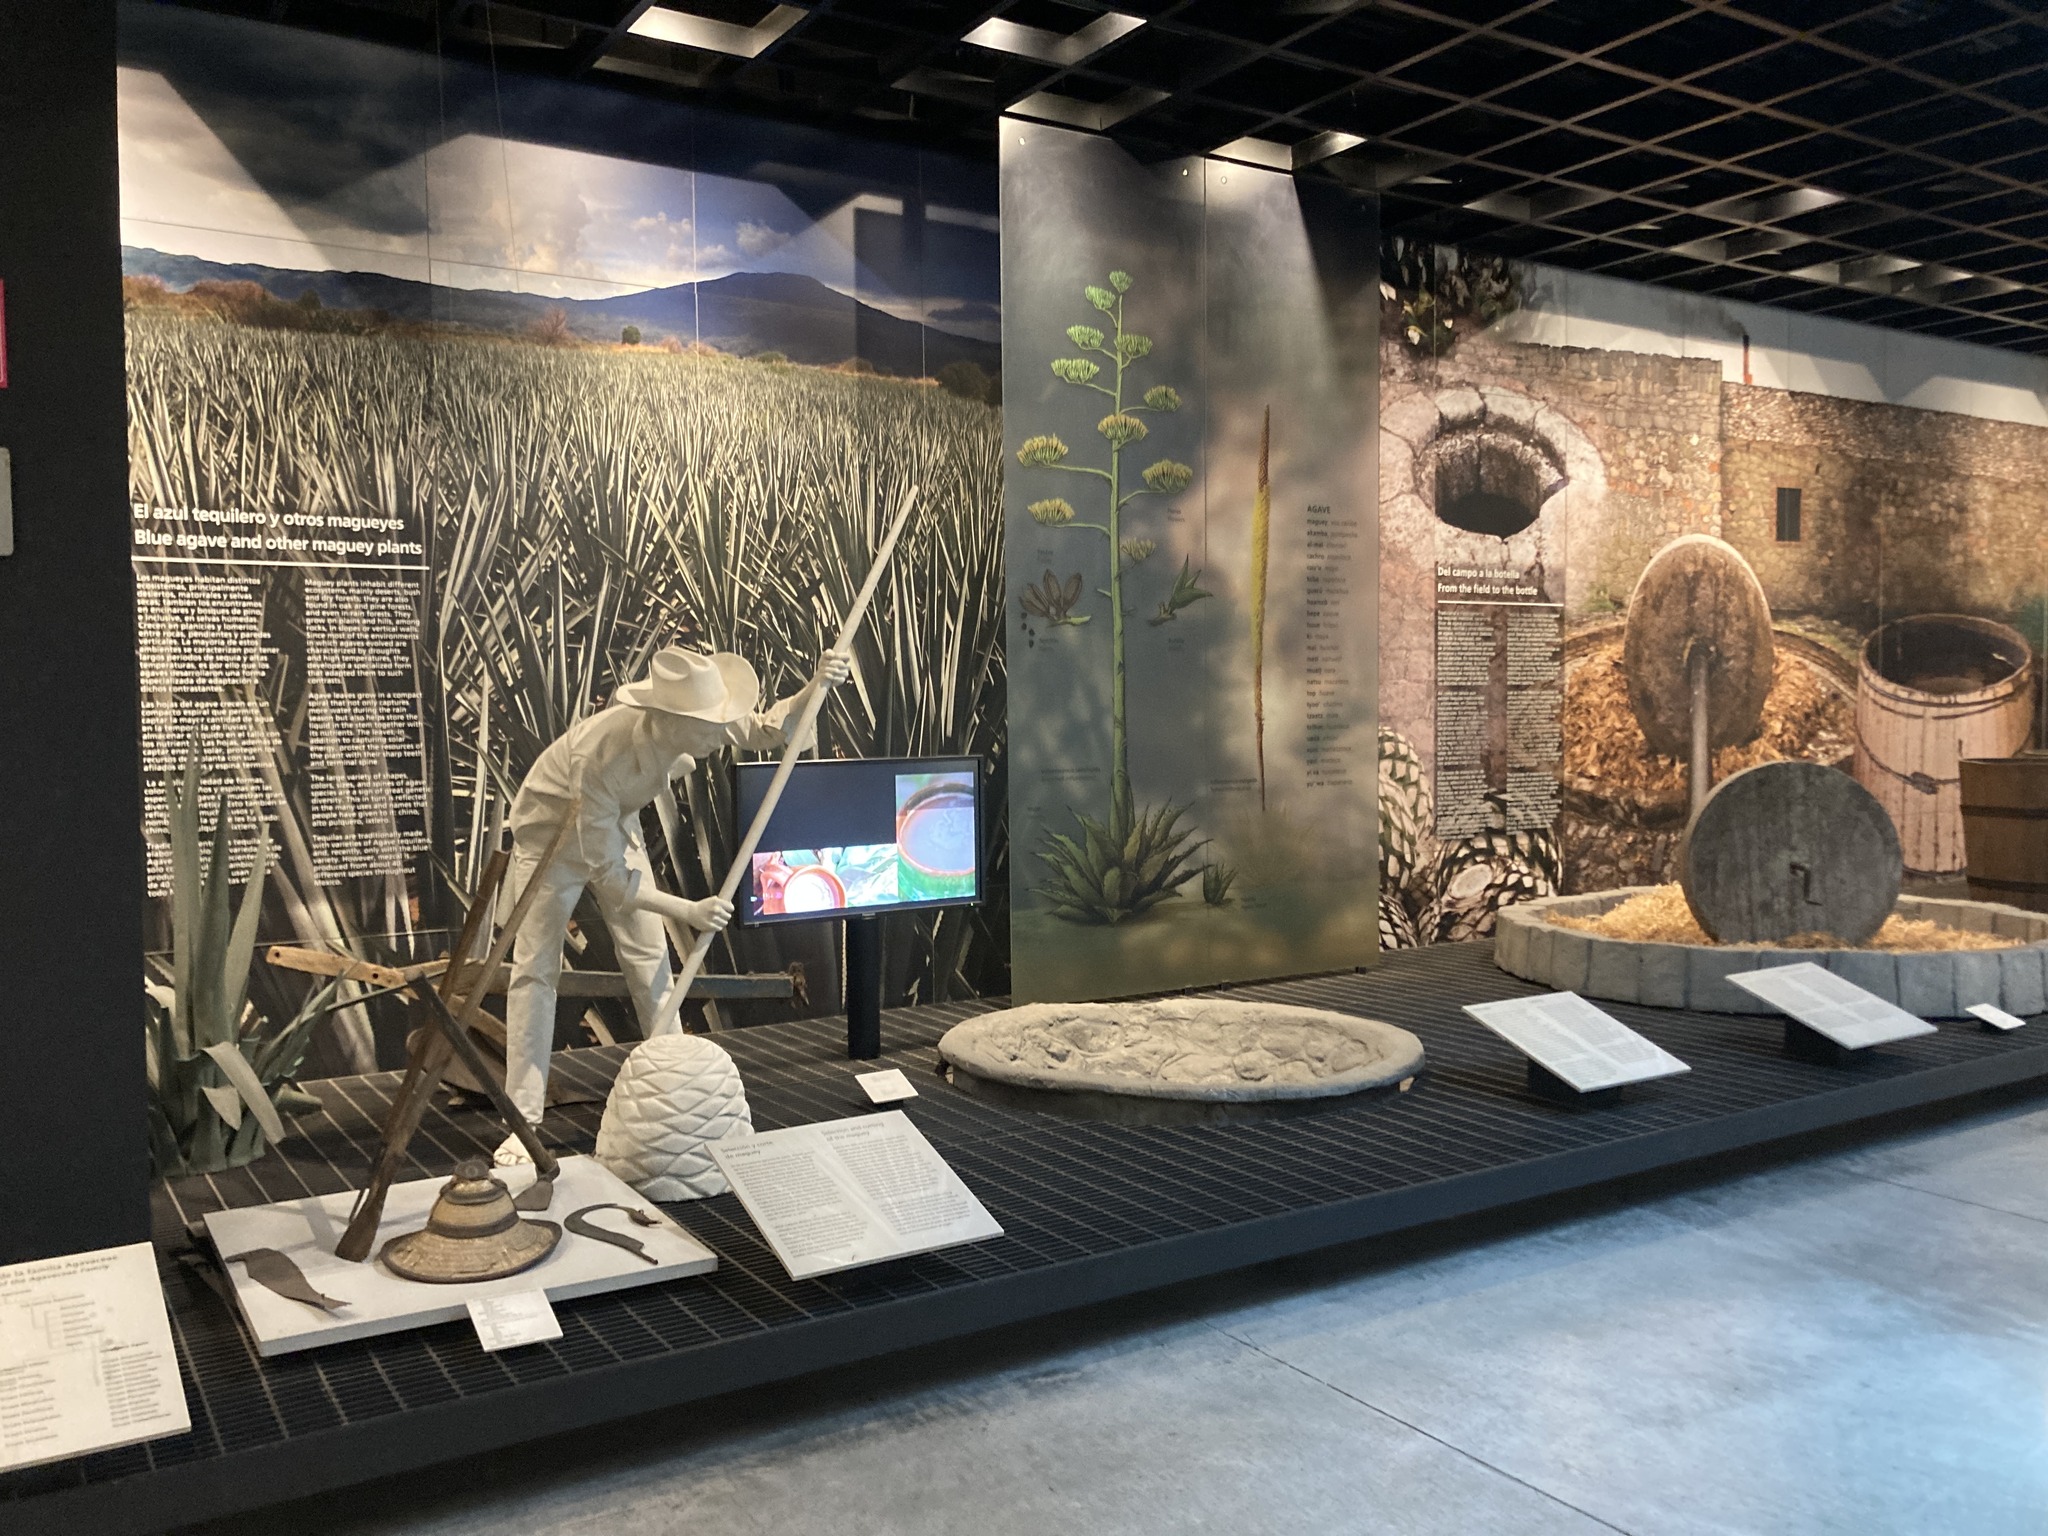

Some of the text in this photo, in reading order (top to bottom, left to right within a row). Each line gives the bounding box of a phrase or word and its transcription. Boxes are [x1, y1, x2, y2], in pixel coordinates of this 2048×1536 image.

[1307, 505, 1330, 514] AGAVE
[134, 504, 404, 533] El azul tequilero y otros magueyes
[135, 529, 422, 556] Blue agave and other maguey plants
[1438, 567, 1451, 576] Del
[1453, 569, 1477, 579] campo
[1486, 569, 1492, 578] la
[1494, 569, 1520, 579] botella
[195, 576, 226, 584] habitan
[228, 576, 260, 584] distintos
[305, 579, 334, 587] Maguey
[337, 580, 358, 588] plants
[189, 584, 248, 593] principalmente
[349, 588, 373, 596] mainly
[1438, 583, 1538, 595] From the field to the bottle
[322, 595, 333, 603] dry
[313, 835, 342, 843] Tequilas
[358, 832, 401, 840] traditionally
[373, 839, 395, 847] Agave
[314, 863, 348, 872] produced
[348, 869, 372, 877] species
[375, 868, 415, 876] throughout
